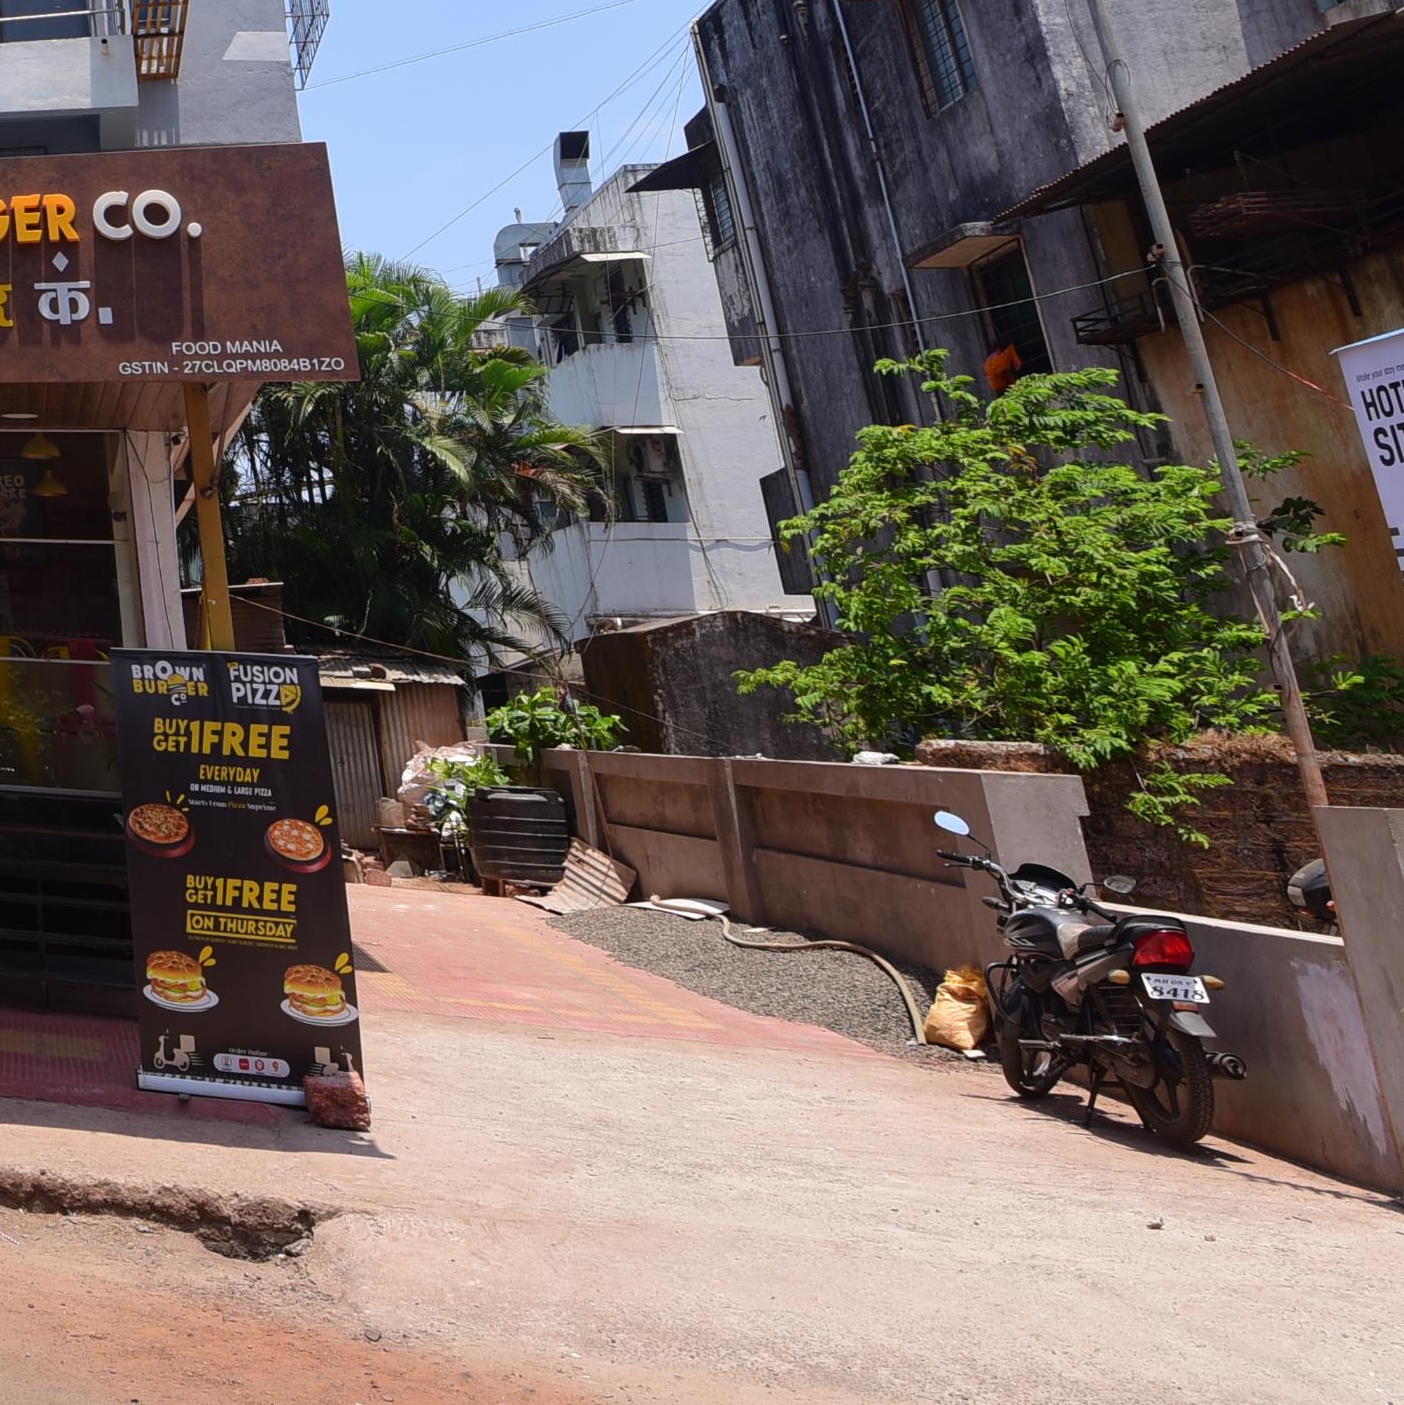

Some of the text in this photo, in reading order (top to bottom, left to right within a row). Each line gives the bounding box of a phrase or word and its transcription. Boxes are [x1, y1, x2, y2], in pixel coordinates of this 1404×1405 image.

[93, 188, 202, 242] CO.
[172, 340, 283, 355] FOOD MANIA
[119, 361, 169, 375] GSTIN
[1361, 379, 1404, 422] HOT
[131, 660, 205, 682] BROWN
[229, 664, 299, 684] FUSION
[153, 718, 189, 735] BUY
[153, 735, 188, 752] GET
[199, 764, 260, 783] EVERYDAY
[190, 782, 200, 791] ON
[200, 783, 226, 794] MEDIUM
[234, 785, 253, 796] LARGE
[254, 787, 272, 797] PIZZA
[186, 874, 215, 889] BUY
[185, 889, 214, 904] GET
[192, 915, 294, 938] ON THURSDAY
[1151, 985, 1205, 1000] 8418
